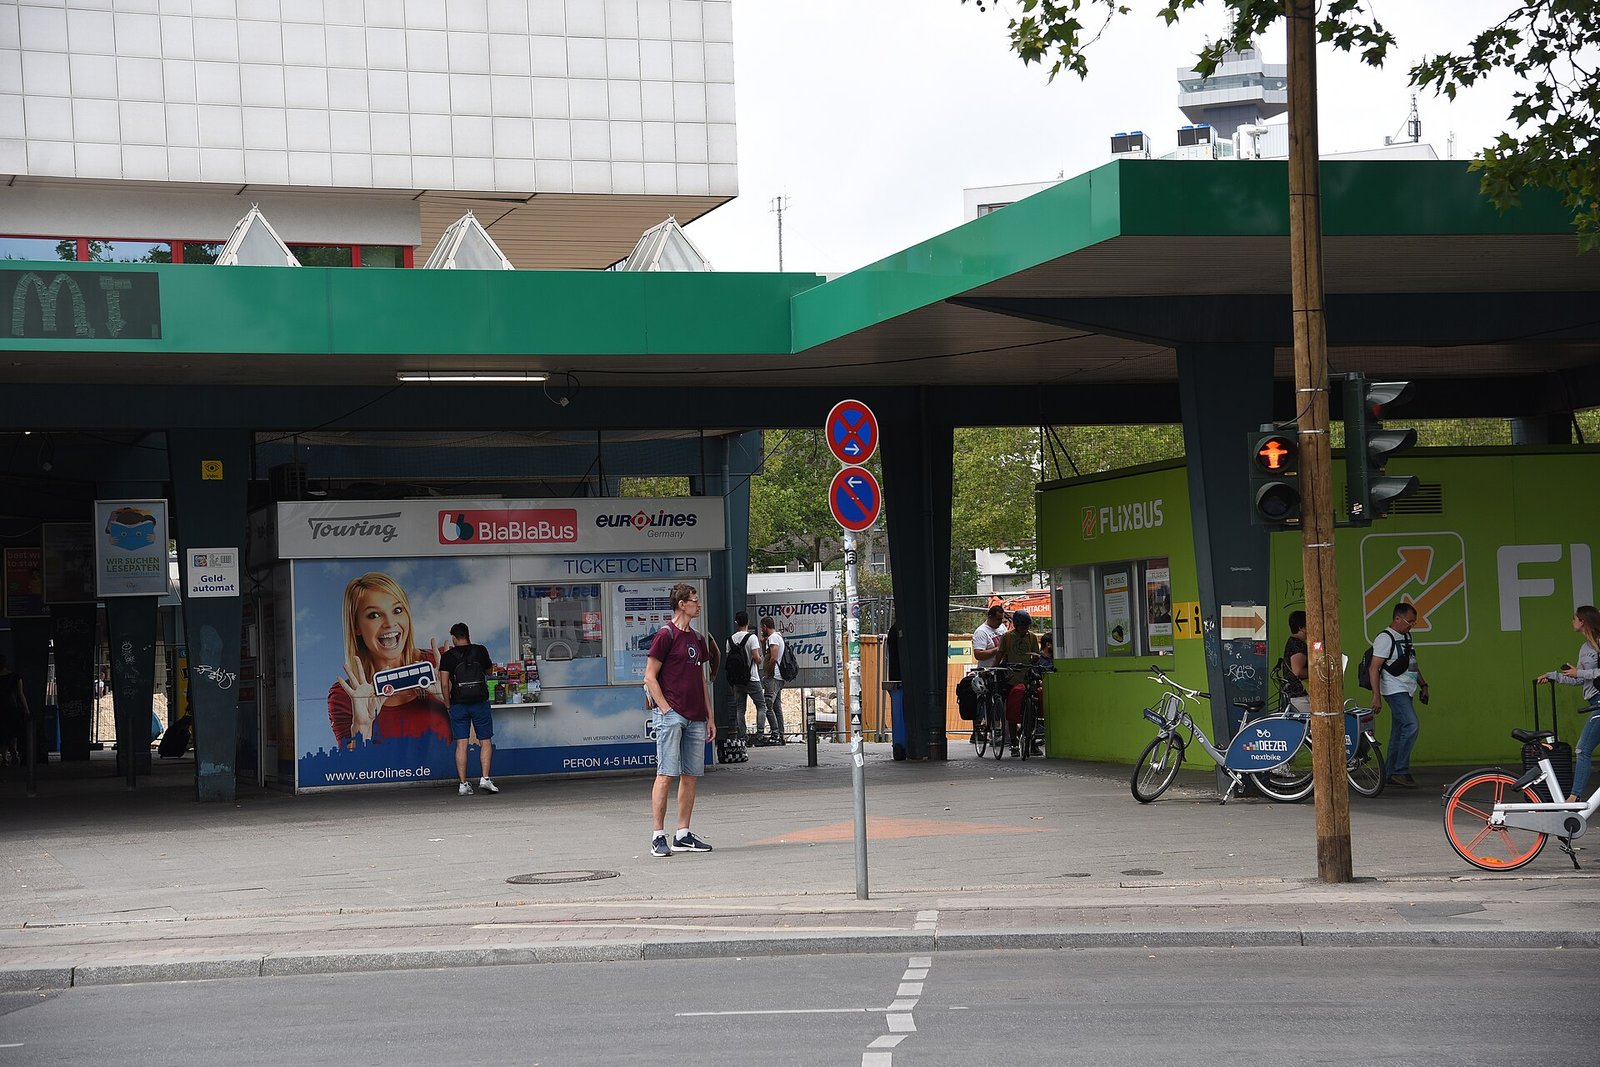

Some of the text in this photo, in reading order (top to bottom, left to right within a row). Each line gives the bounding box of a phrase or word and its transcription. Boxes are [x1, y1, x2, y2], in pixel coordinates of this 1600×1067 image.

[308, 511, 402, 543] Touring
[479, 520, 574, 541] BlaBlaBus
[647, 529, 685, 539] Germany
[106, 564, 160, 572] LESEPATEN
[563, 557, 698, 574] TICKETCENTER
[200, 574, 226, 582] Geld-
[192, 584, 234, 592] automat
[1023, 604, 1050, 613] HITACHI
[1259, 740, 1288, 752] DEEZER
[563, 757, 601, 768] PERON
[603, 756, 620, 767] 4-5
[1250, 753, 1282, 761] nextbike
[324, 766, 431, 783] www.eurolines.de
